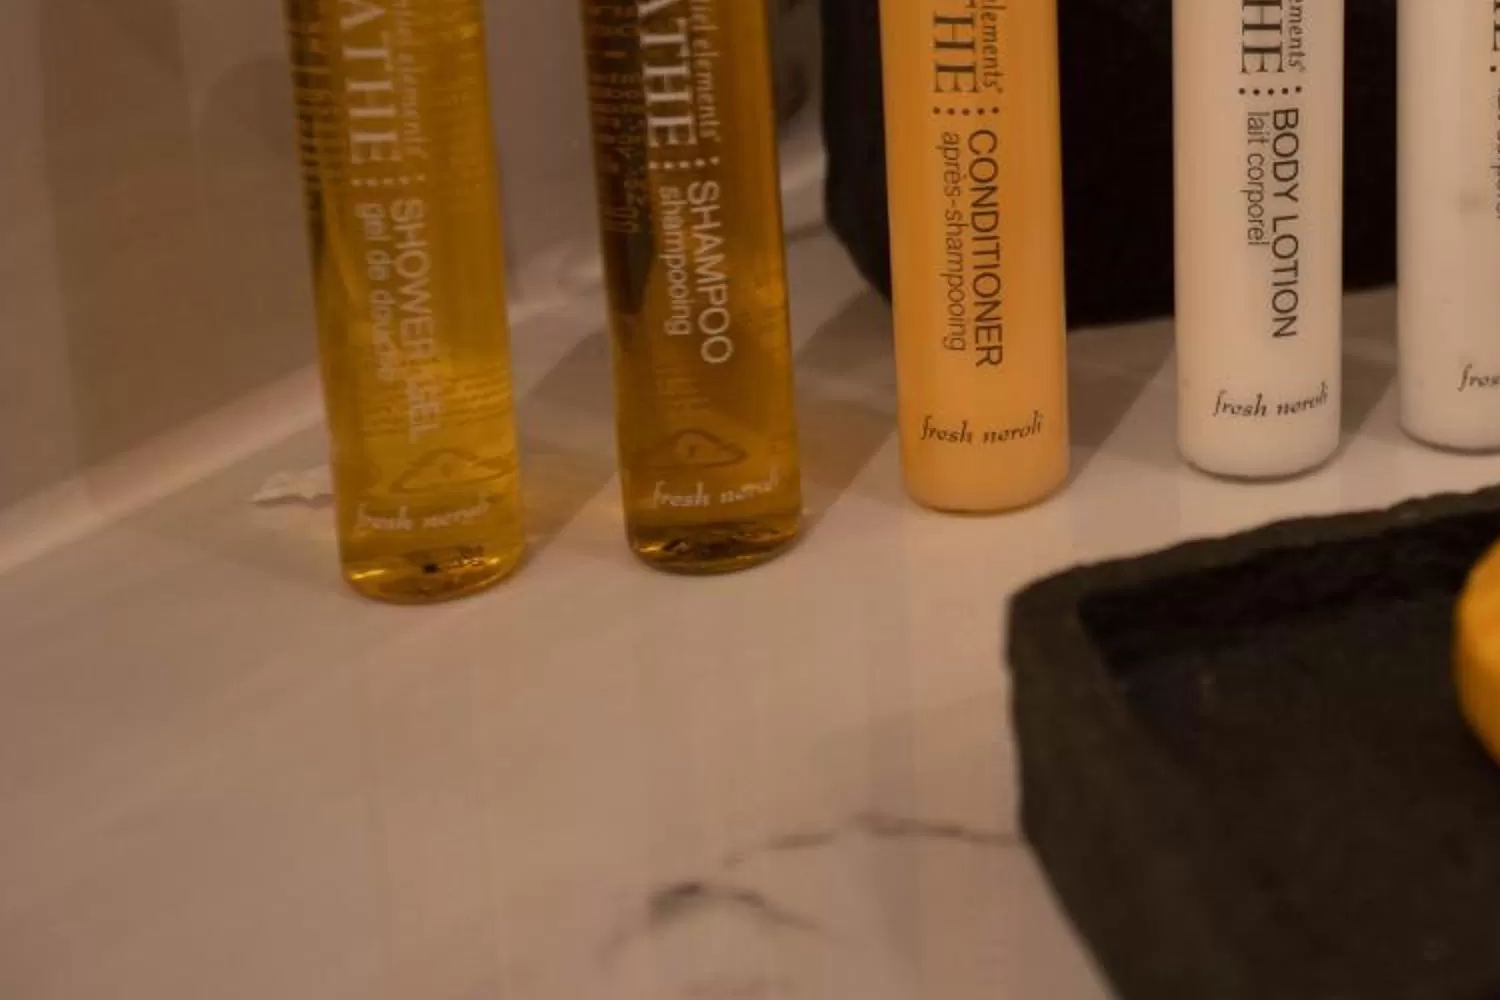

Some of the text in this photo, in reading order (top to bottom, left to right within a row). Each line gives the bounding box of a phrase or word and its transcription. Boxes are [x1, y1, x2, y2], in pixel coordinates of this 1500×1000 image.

[356, 204, 389, 240] gel
[941, 132, 970, 351] après-shampooing
[967, 130, 1003, 367] CONDITIONER
[1242, 112, 1270, 247] lait corporel
[1272, 108, 1300, 337] BODY LOTION
[367, 250, 394, 280] de
[391, 198, 439, 360] SHOWER
[658, 185, 694, 336] shampooing
[687, 181, 733, 363] SHAMPOO
[921, 409, 1044, 444] fresh neroli
[1212, 389, 1268, 417] fresh
